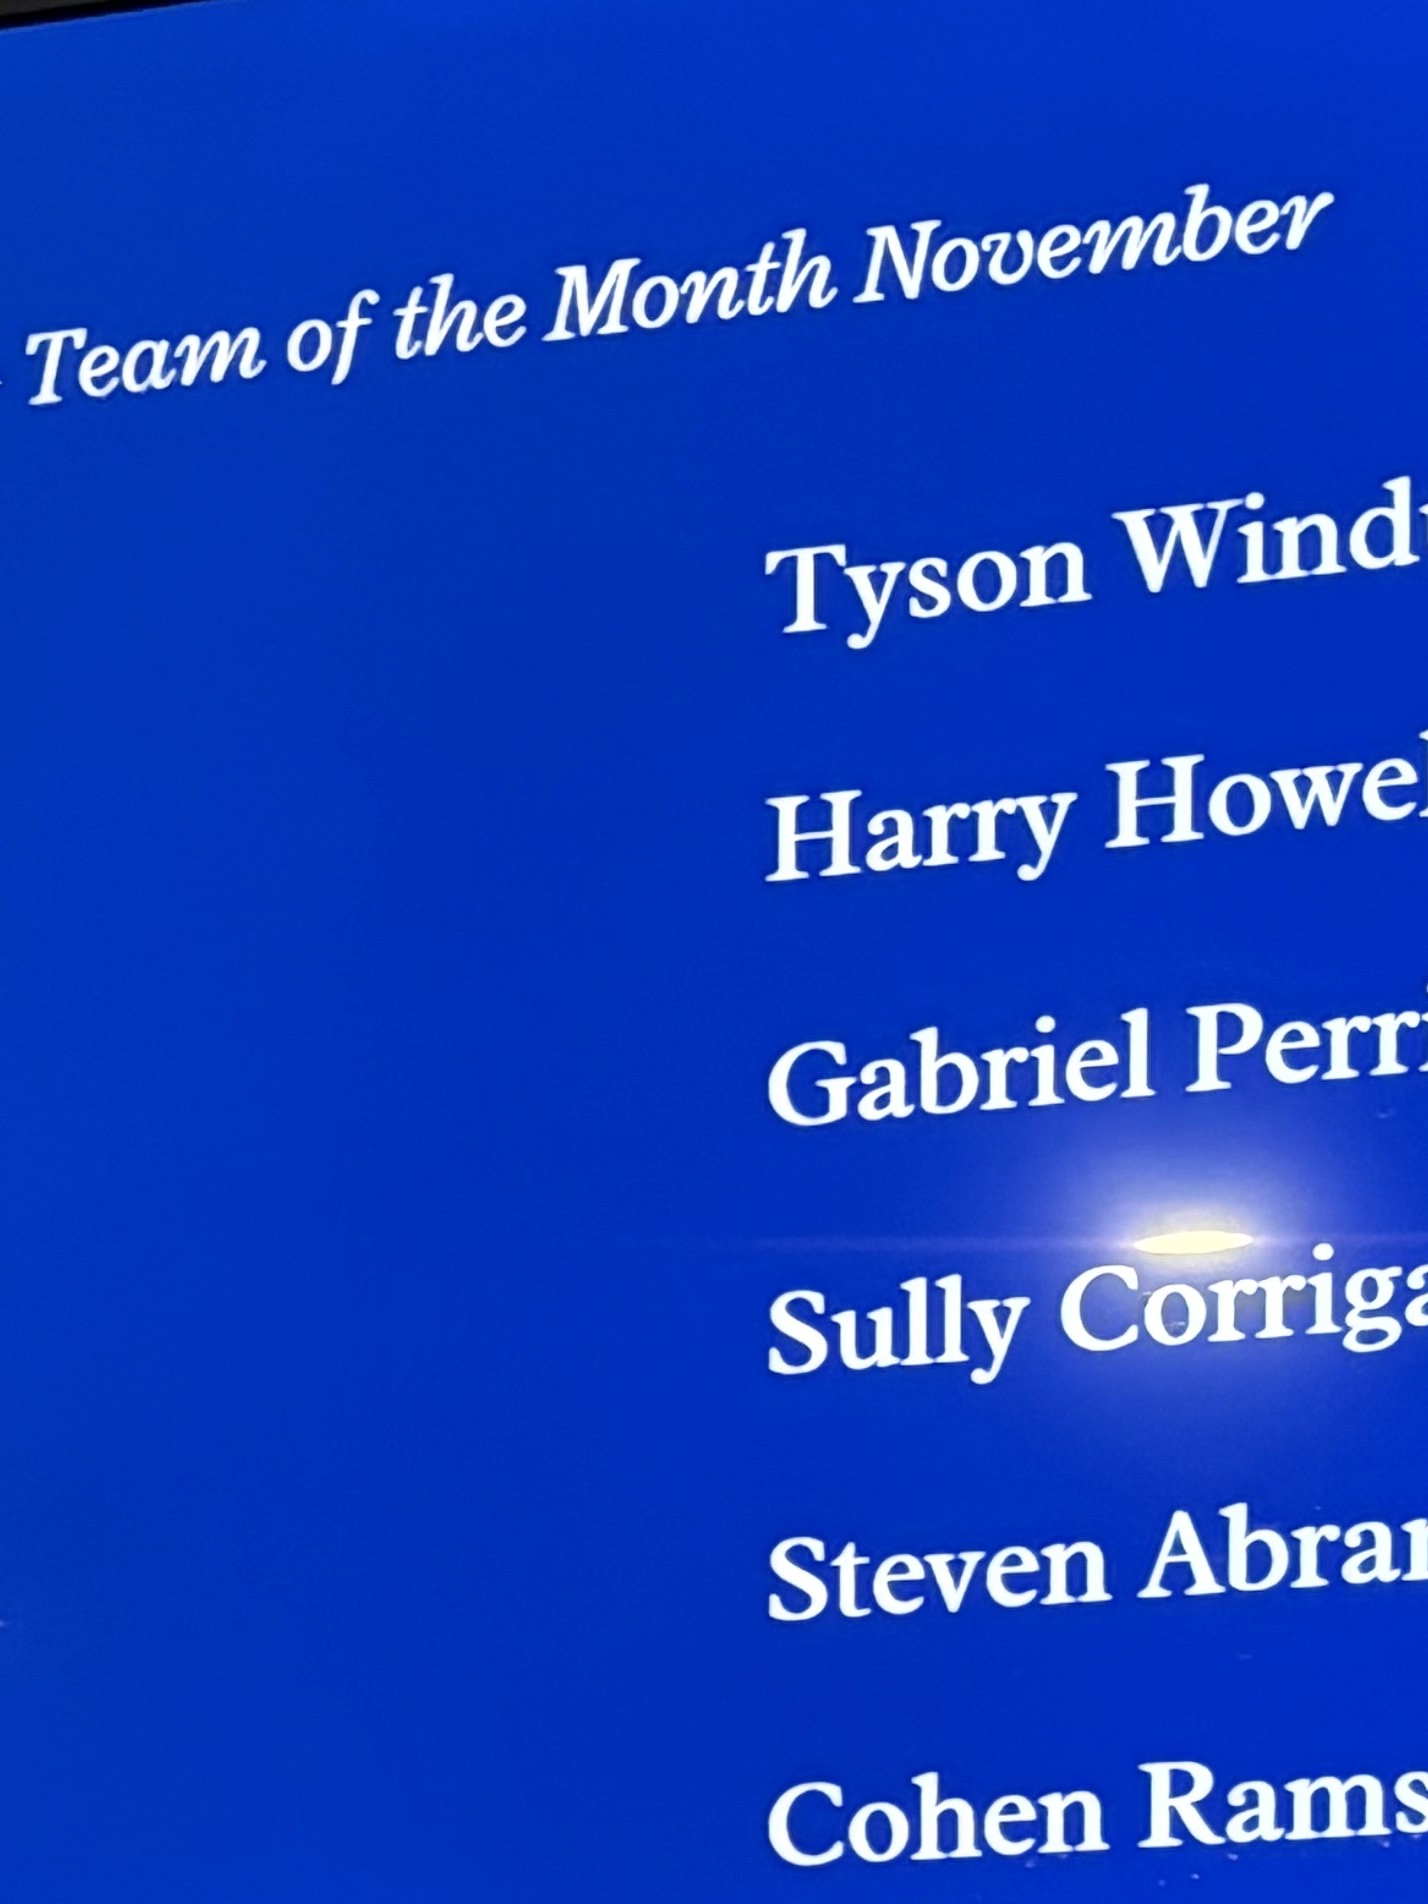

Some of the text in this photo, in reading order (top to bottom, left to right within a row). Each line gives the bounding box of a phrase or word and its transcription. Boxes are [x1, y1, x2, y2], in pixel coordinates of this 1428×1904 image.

[26, 326, 266, 405] Team
[288, 290, 379, 385] of
[394, 273, 526, 360] the
[543, 229, 837, 342] Month
[854, 184, 1334, 303] November
[766, 542, 1091, 650] Tyson
[766, 789, 1077, 882] Harry
[768, 1007, 1156, 1127] Gabriel
[768, 1273, 1030, 1385] Sully
[768, 1536, 1113, 1621] Steven
[768, 1771, 1110, 1867] Cohen
